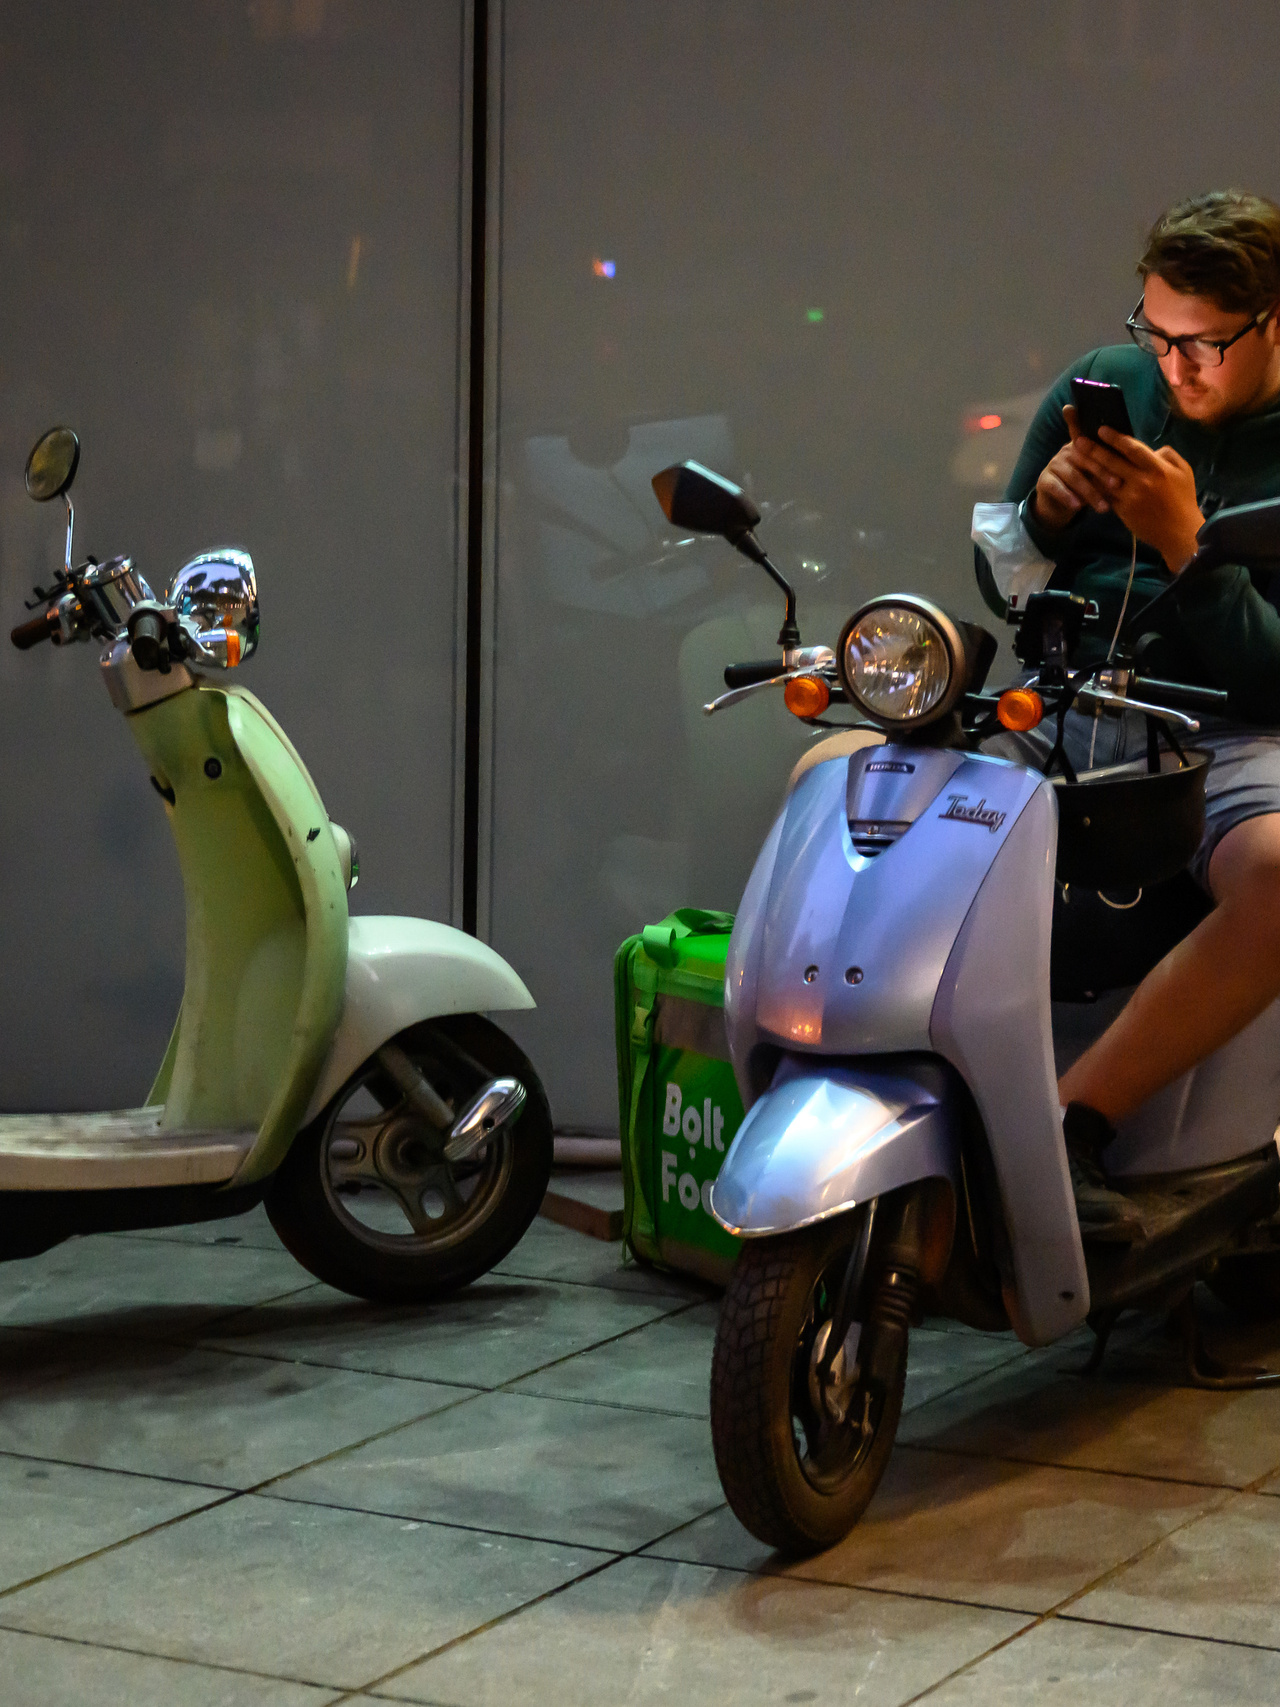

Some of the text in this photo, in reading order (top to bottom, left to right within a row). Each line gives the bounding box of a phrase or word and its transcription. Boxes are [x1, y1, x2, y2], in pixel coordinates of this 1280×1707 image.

[939, 793, 1006, 834] Today
[662, 1082, 725, 1158] Bolt
[661, 1150, 716, 1217] Foo
